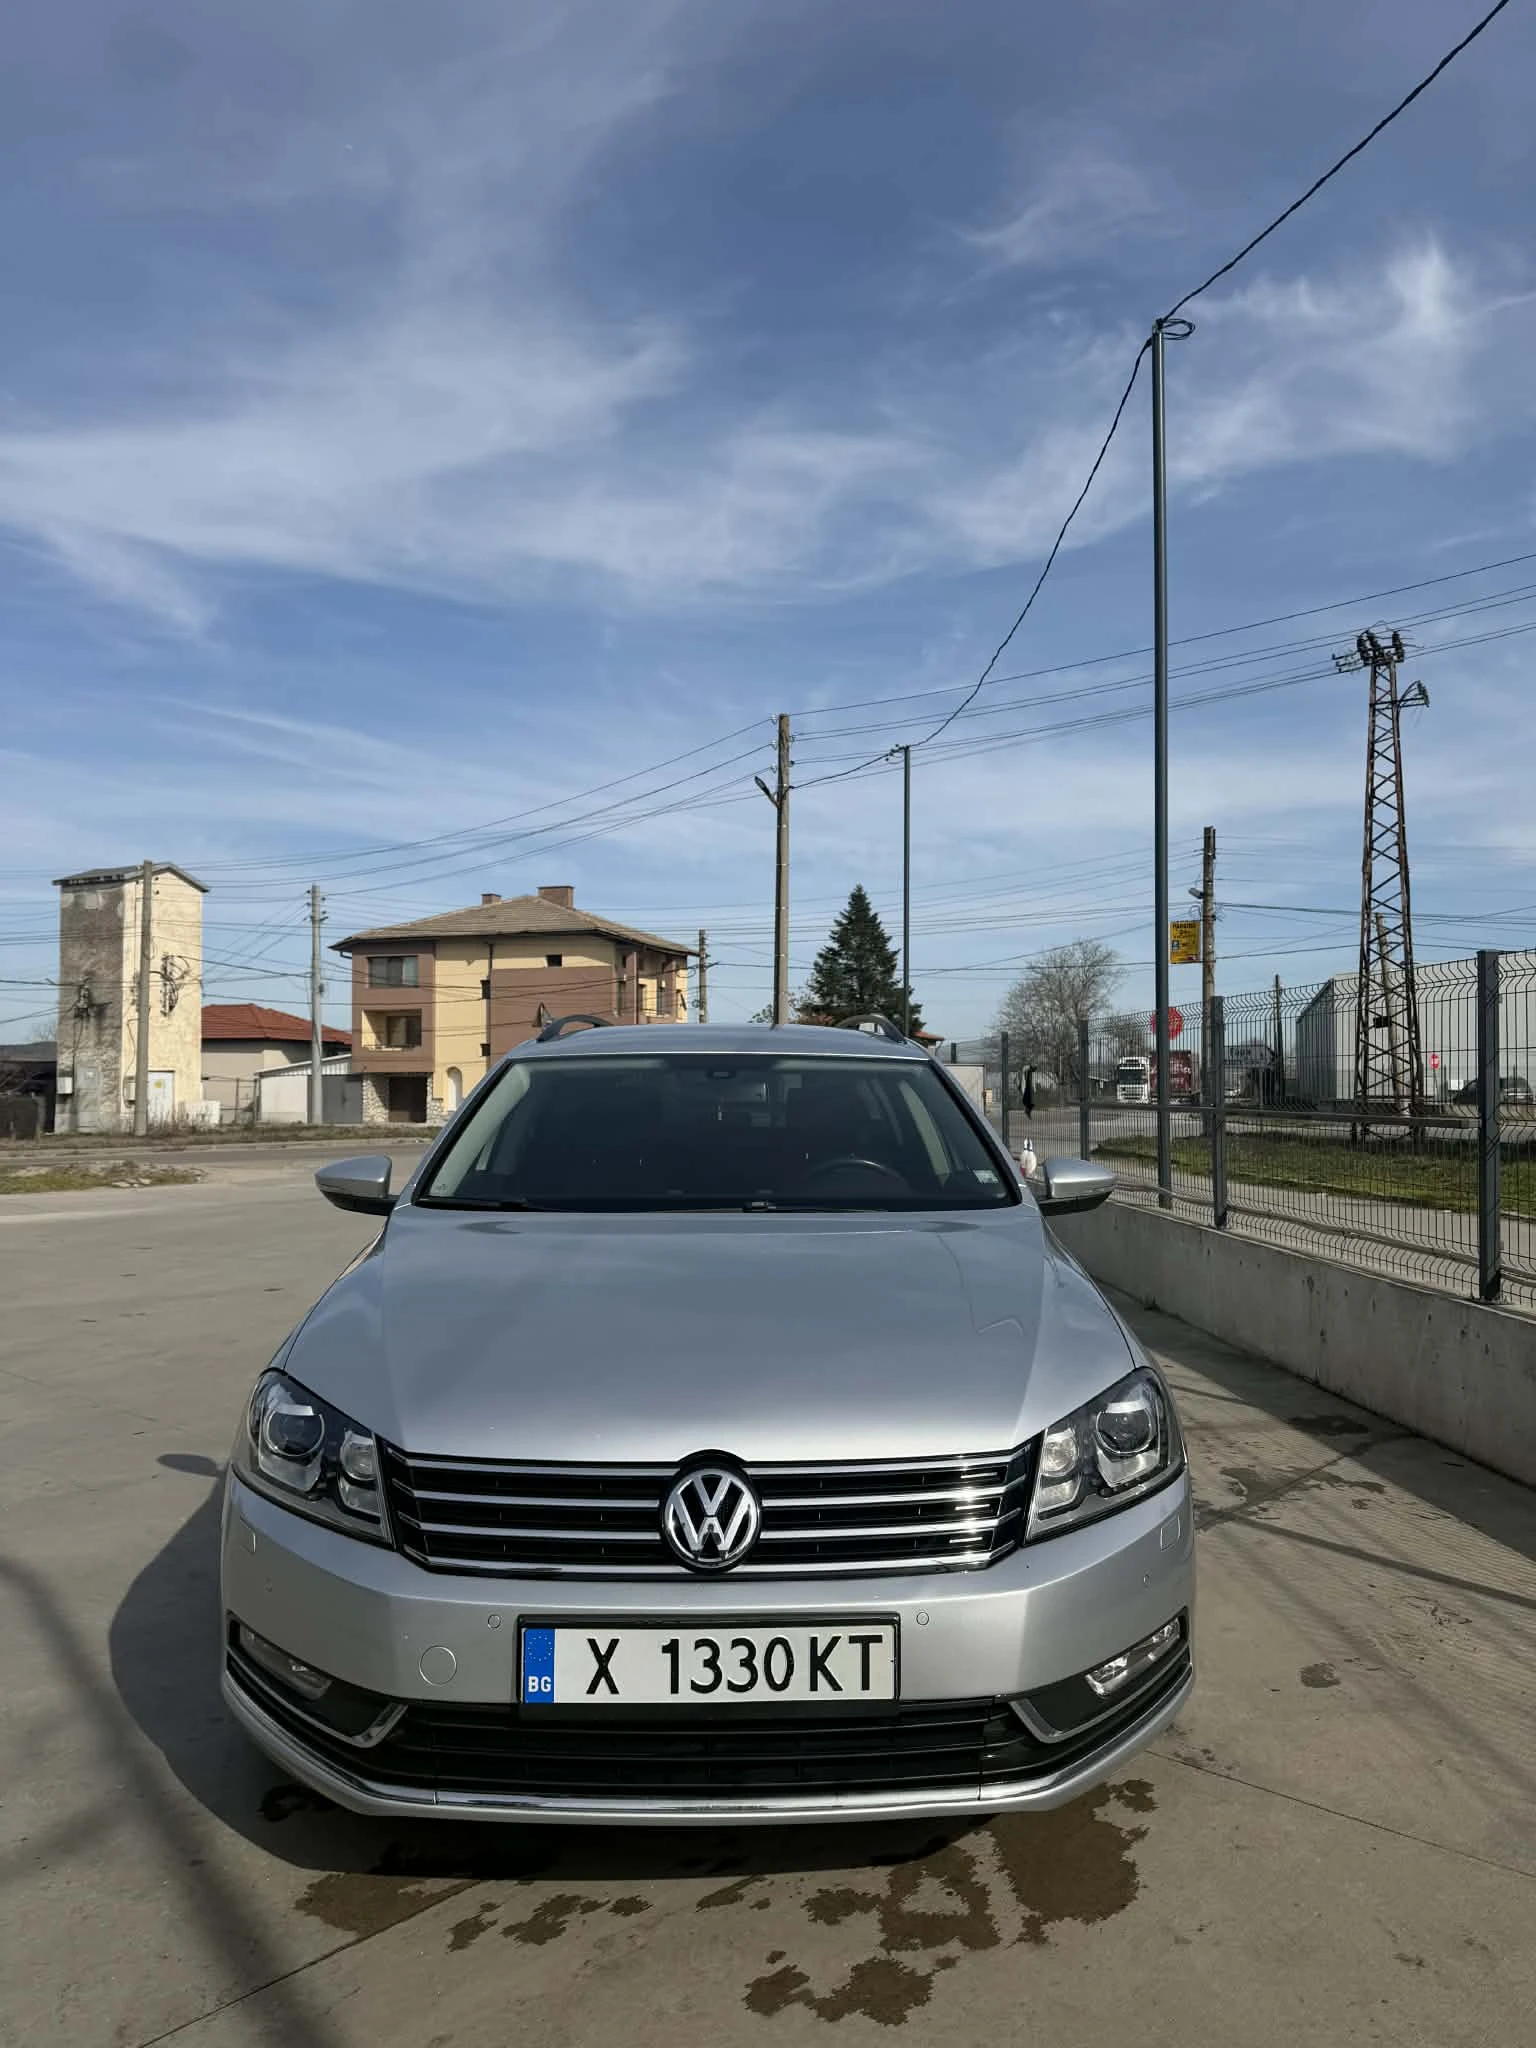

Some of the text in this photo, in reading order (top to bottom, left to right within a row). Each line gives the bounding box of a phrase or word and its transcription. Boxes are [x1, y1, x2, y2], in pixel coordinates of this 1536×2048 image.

[668, 1471, 753, 1561] VW
[528, 1676, 552, 1693] BG
[585, 1638, 620, 1695] X
